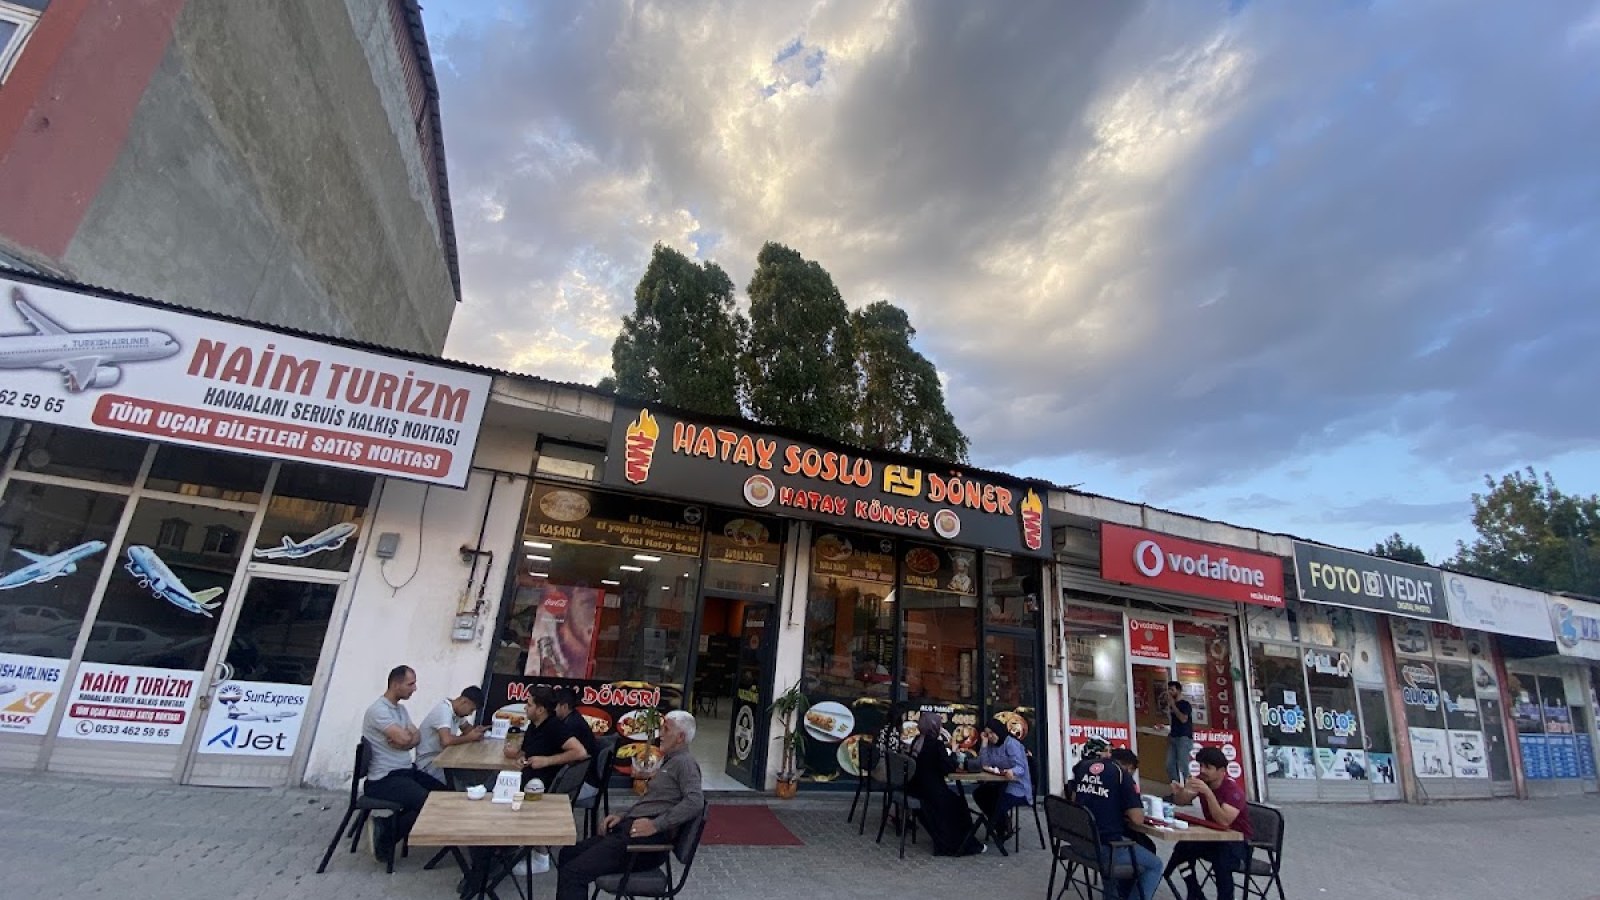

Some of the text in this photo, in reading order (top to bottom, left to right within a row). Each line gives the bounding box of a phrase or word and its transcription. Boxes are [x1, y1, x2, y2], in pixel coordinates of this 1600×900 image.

[112, 336, 149, 345] AIRLINES
[187, 338, 472, 424] NAİM TURİZM
[20, 392, 42, 410] 59
[44, 396, 65, 413] 65
[203, 386, 461, 446] HAVAALANI SERVİS KALKIŞ NOKTASI
[108, 401, 442, 470] TÜM UÇAK BİLETLERİ SATIŞ NOKTASI
[672, 421, 778, 471] HATAY
[783, 444, 874, 488] SOSLU
[927, 470, 1014, 516] DÖNER
[779, 486, 931, 530] HATAY KÜNEFE
[1167, 553, 1265, 588] vodafone
[1308, 561, 1434, 606] FOTO VEDAT
[16, 665, 61, 682] AIRLINES
[80, 670, 194, 698] NAİM TURİZM
[243, 689, 305, 707] SunExpress
[581, 683, 661, 707] DÖNERİ
[95, 723, 171, 738] 0533 462 59 65
